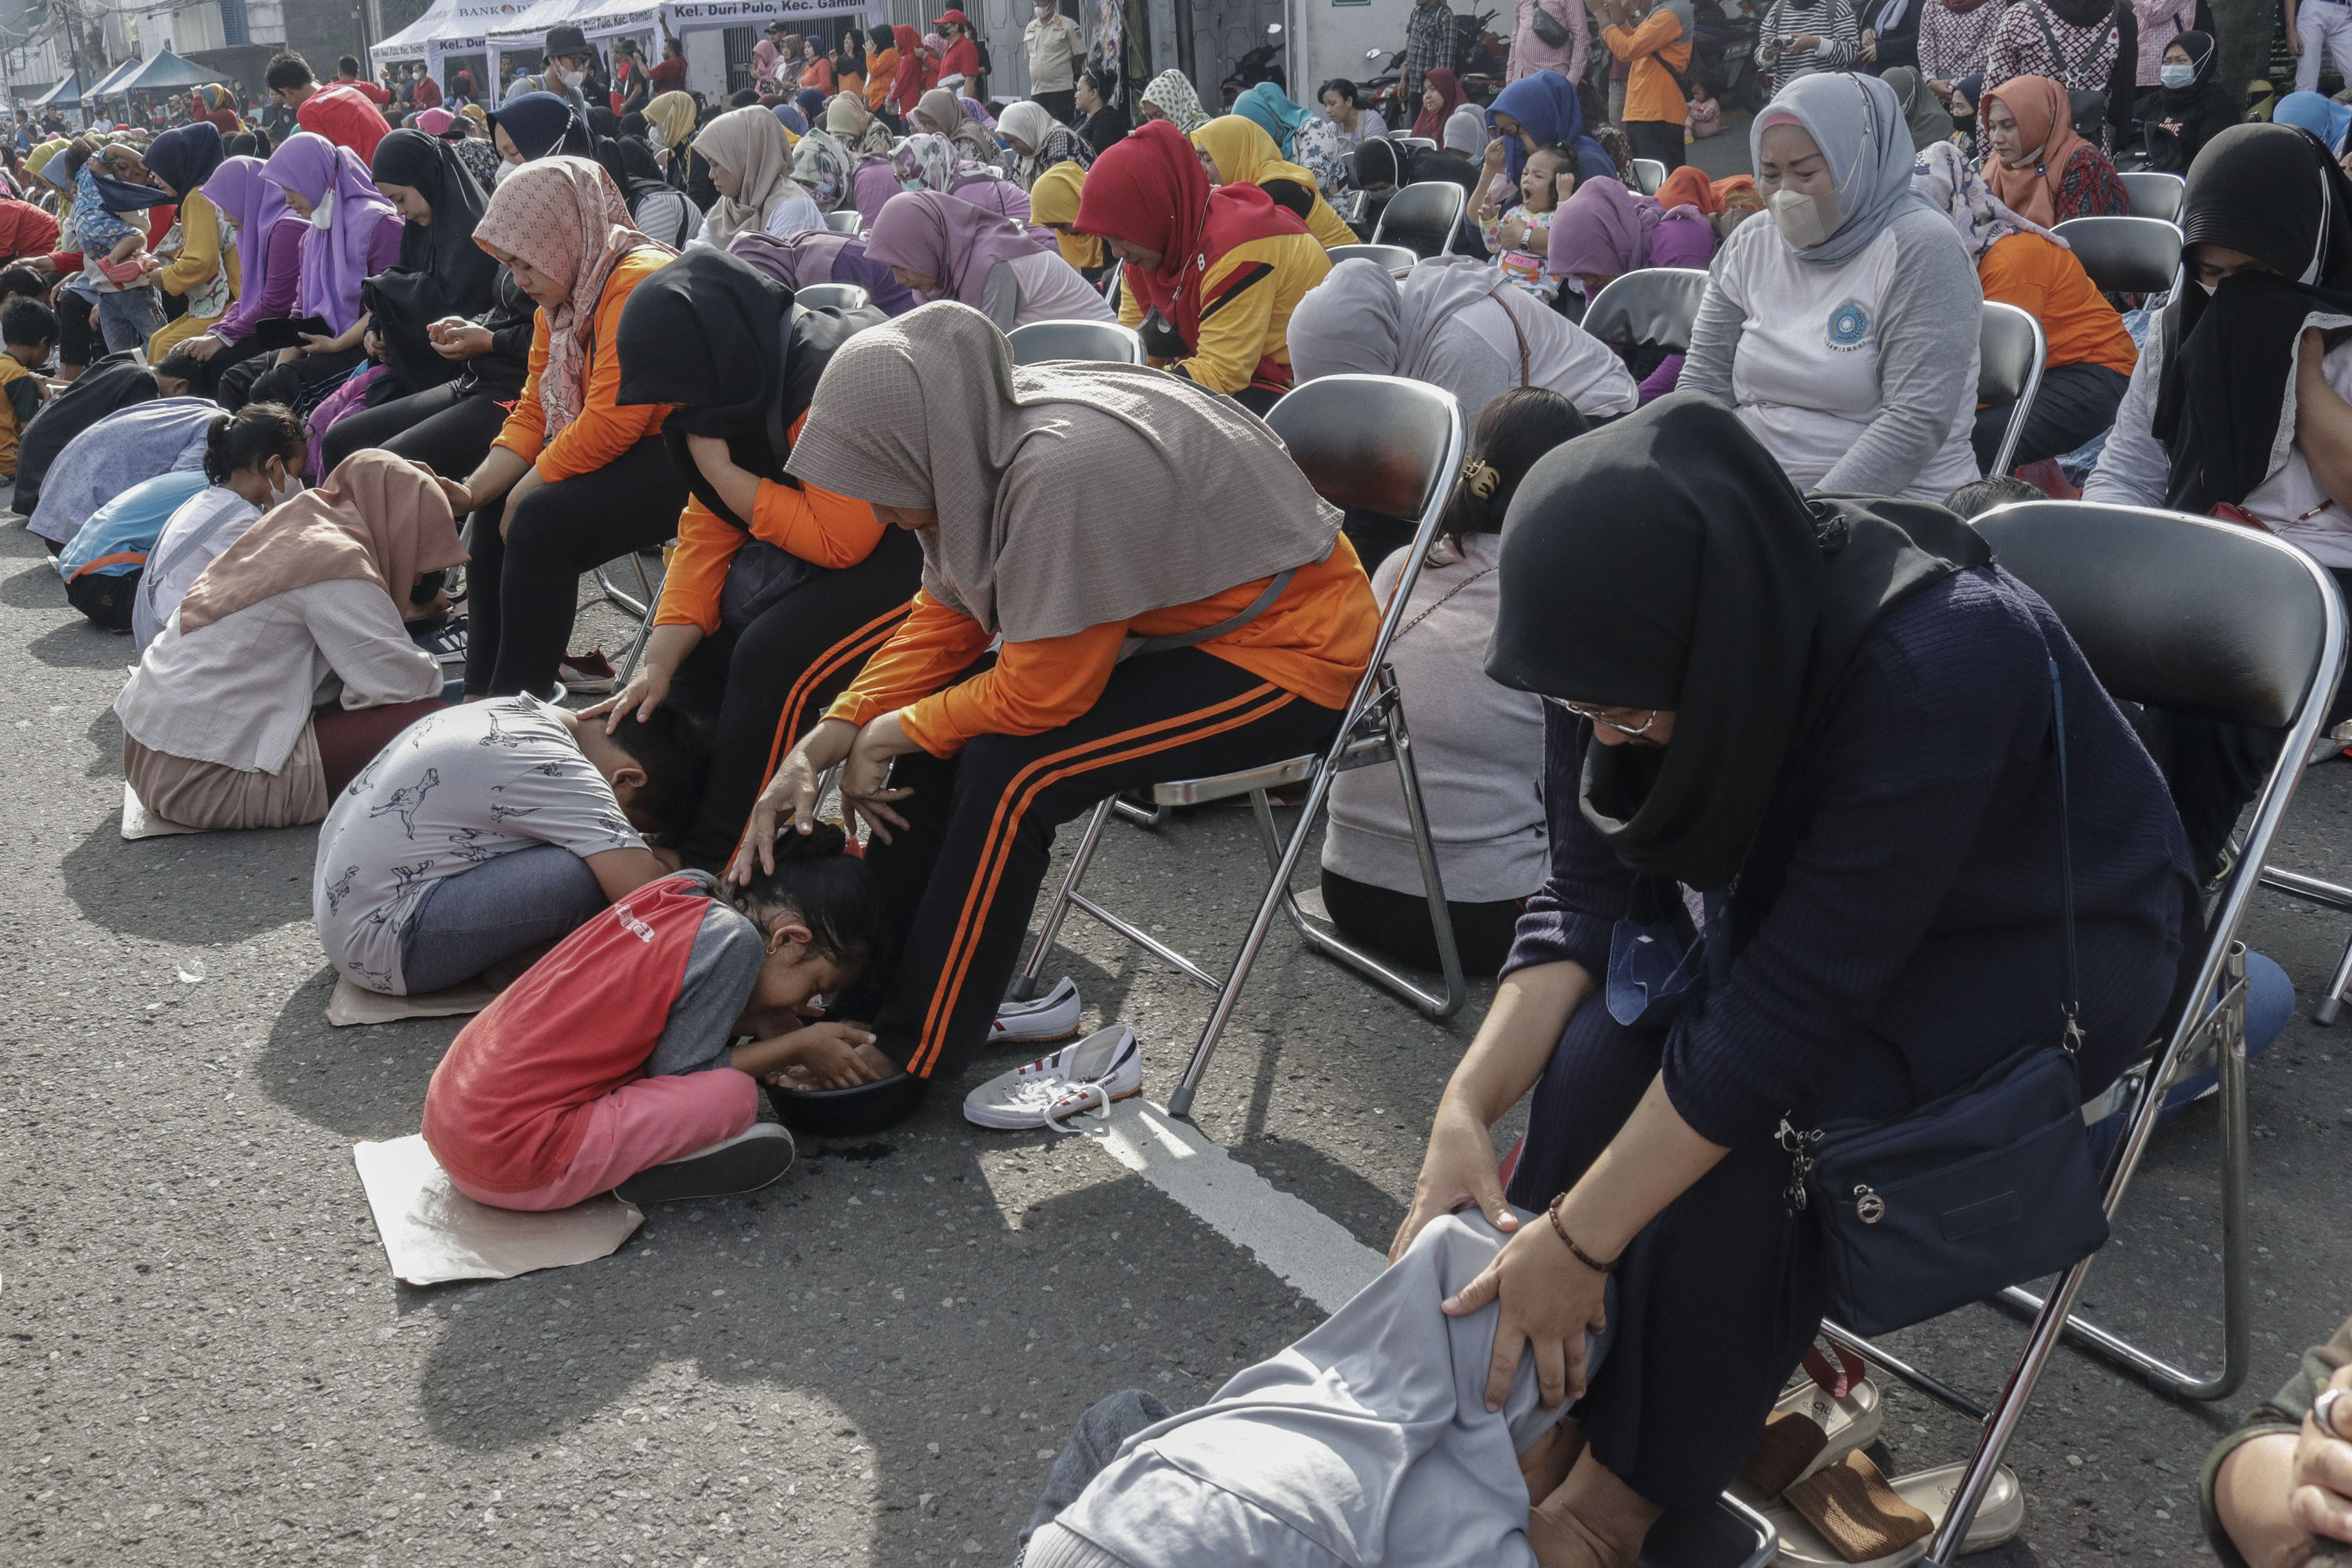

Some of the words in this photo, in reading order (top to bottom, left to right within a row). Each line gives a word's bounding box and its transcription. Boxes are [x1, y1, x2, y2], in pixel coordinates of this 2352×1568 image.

[459, 7, 500, 16] BANK
[675, 5, 703, 17] Kel.
[708, 4, 737, 16] Duri
[743, 2, 777, 14] Pulo,
[782, 0, 813, 11] Kec.
[440, 40, 463, 50] Kel.
[466, 38, 486, 48] Dur
